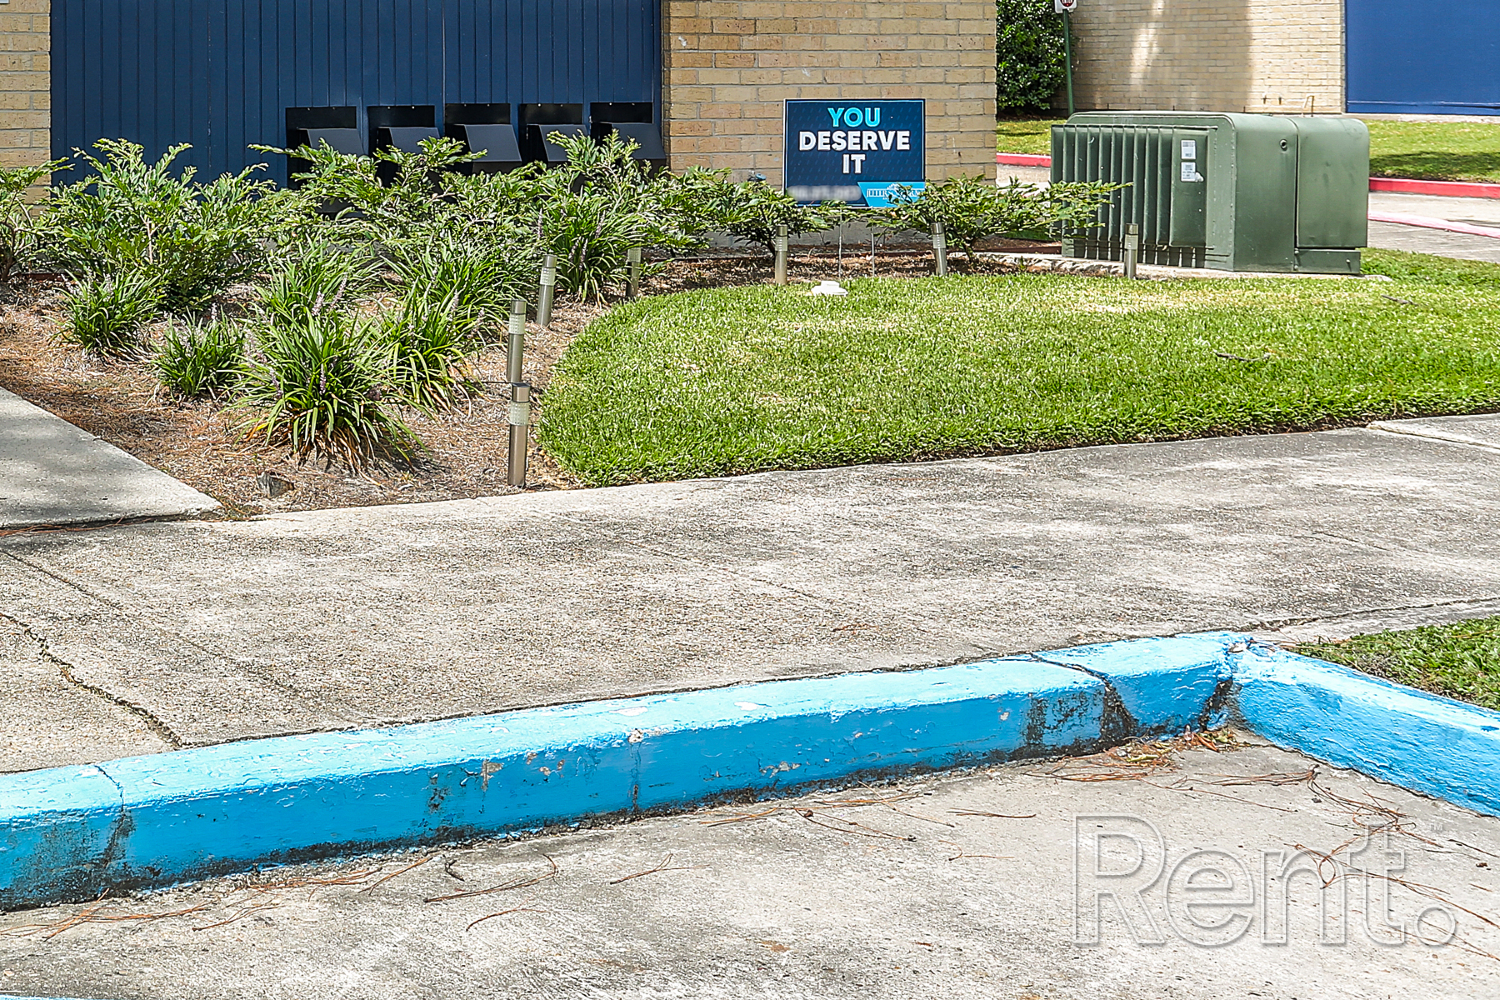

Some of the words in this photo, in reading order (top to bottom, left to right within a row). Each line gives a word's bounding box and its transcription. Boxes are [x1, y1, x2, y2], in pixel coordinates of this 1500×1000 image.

[827, 107, 881, 128] YOU
[799, 130, 911, 151] DESERVE
[842, 153, 866, 174] IT
